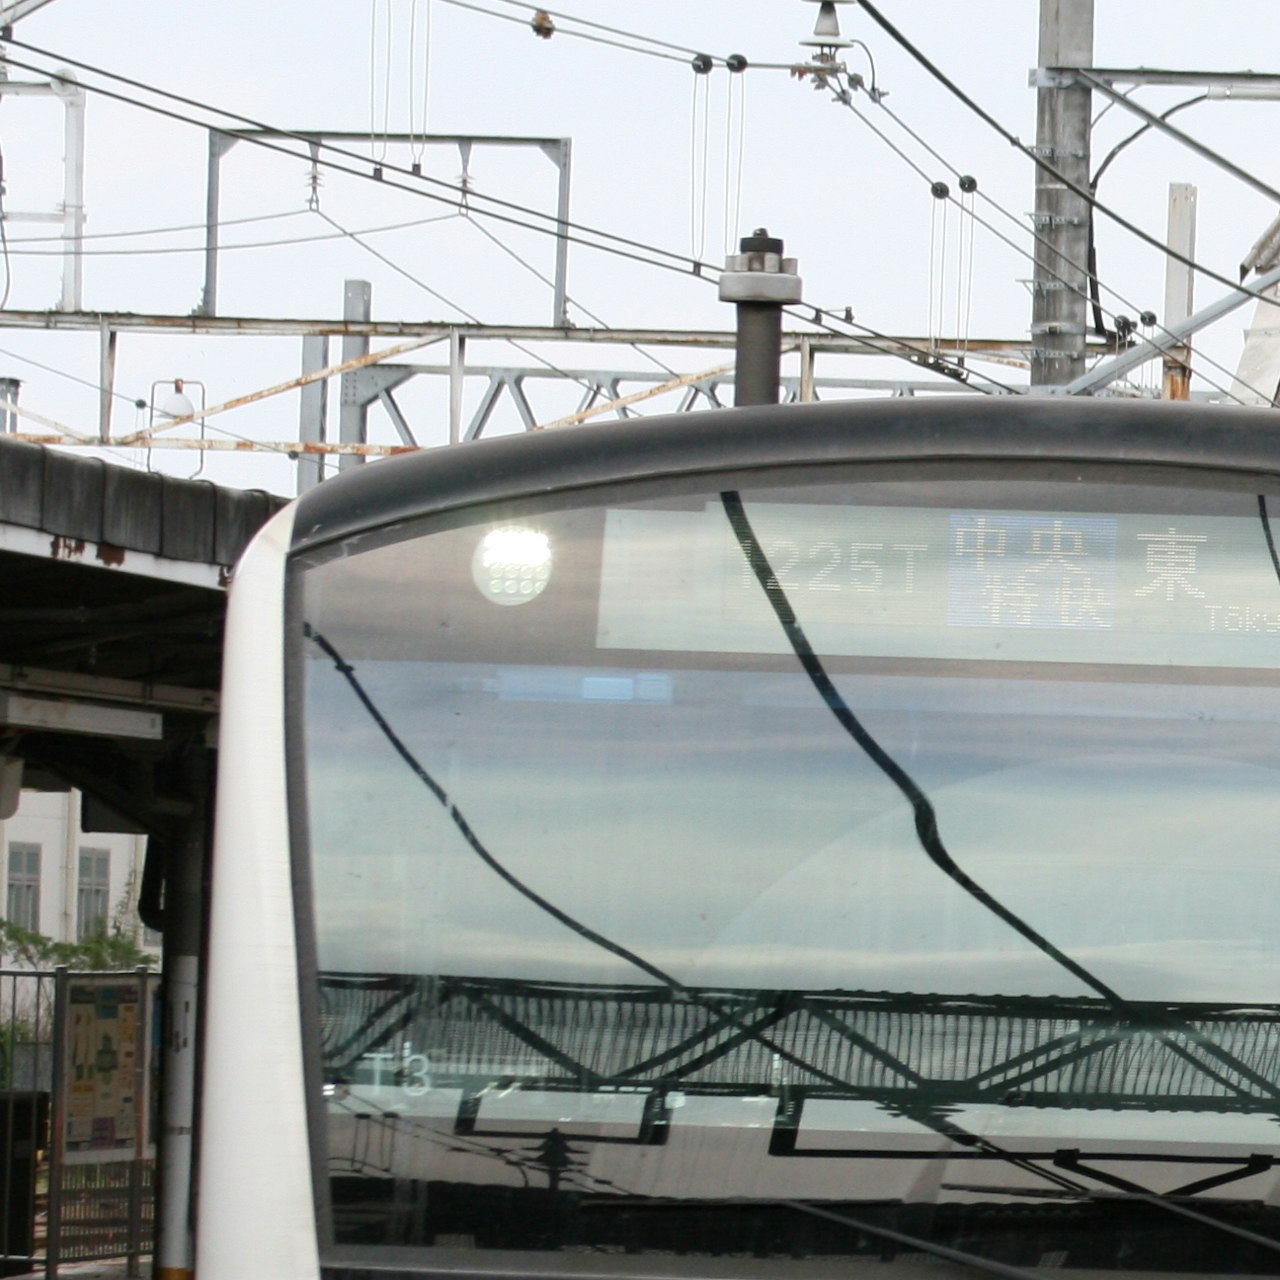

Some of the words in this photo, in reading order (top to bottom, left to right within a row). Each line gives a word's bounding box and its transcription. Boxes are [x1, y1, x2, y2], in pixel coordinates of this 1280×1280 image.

[731, 537, 929, 594] 1225T
[955, 519, 1089, 574] 中央
[983, 574, 1113, 628] 特快
